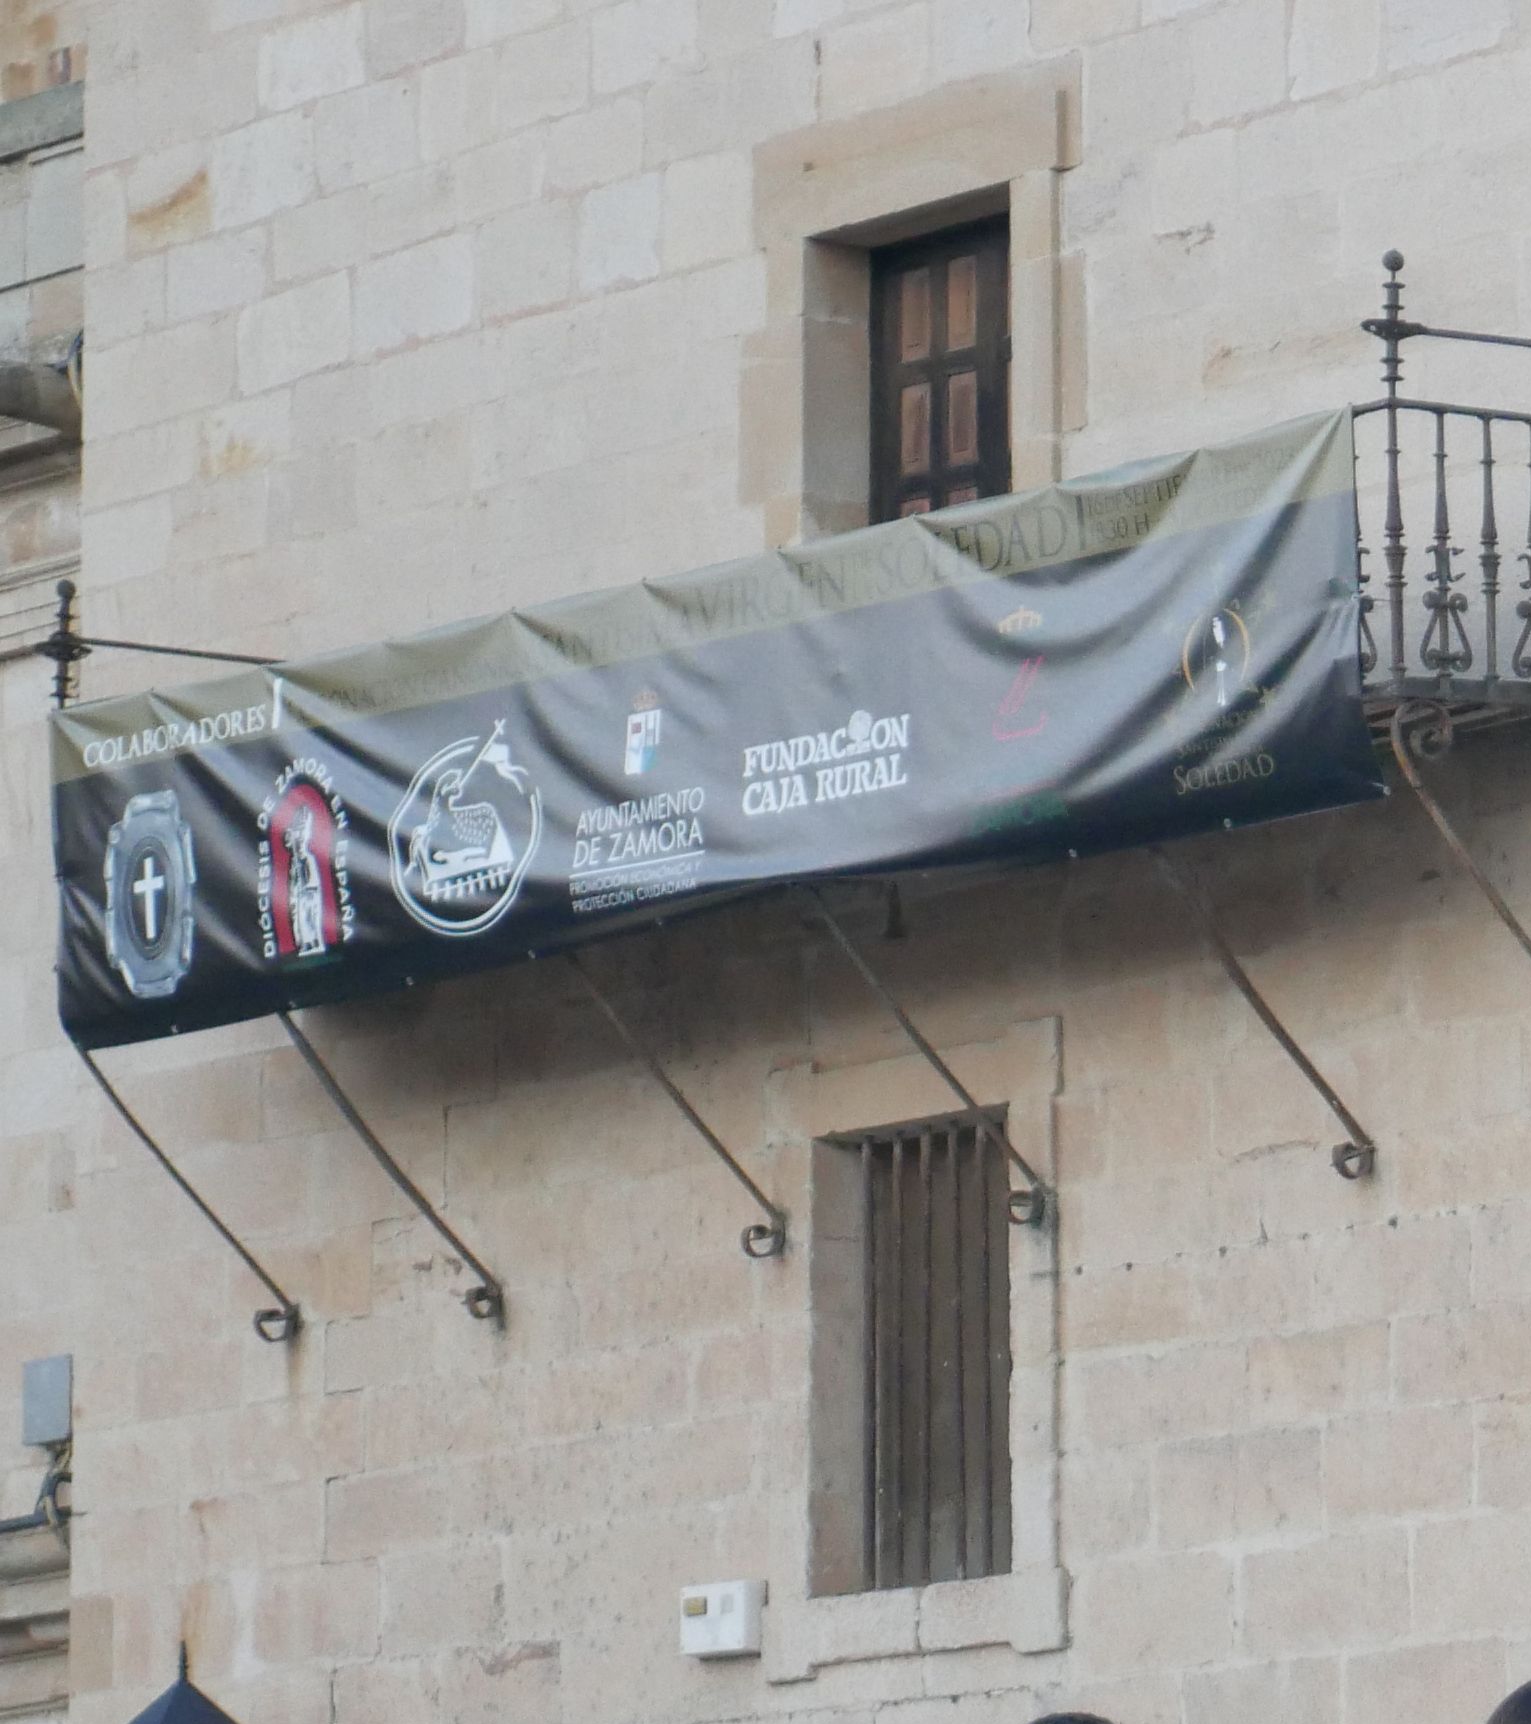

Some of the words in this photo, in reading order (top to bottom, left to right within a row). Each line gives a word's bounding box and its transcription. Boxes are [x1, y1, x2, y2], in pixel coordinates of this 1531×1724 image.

[875, 504, 1067, 595] SOLEDAD
[83, 704, 266, 768] COLABORADORES
[275, 757, 333, 795] ZAMORA
[742, 774, 808, 815] CAJA
[815, 754, 907, 802] RURAL
[1173, 753, 1274, 795] SOLEDAD
[257, 796, 275, 830] DE
[331, 794, 348, 829] EN
[576, 786, 704, 836] AYUNTAMIENTO
[573, 837, 602, 868] DE
[607, 817, 703, 862] ZAMORA
[335, 839, 355, 941] ESPAÑA
